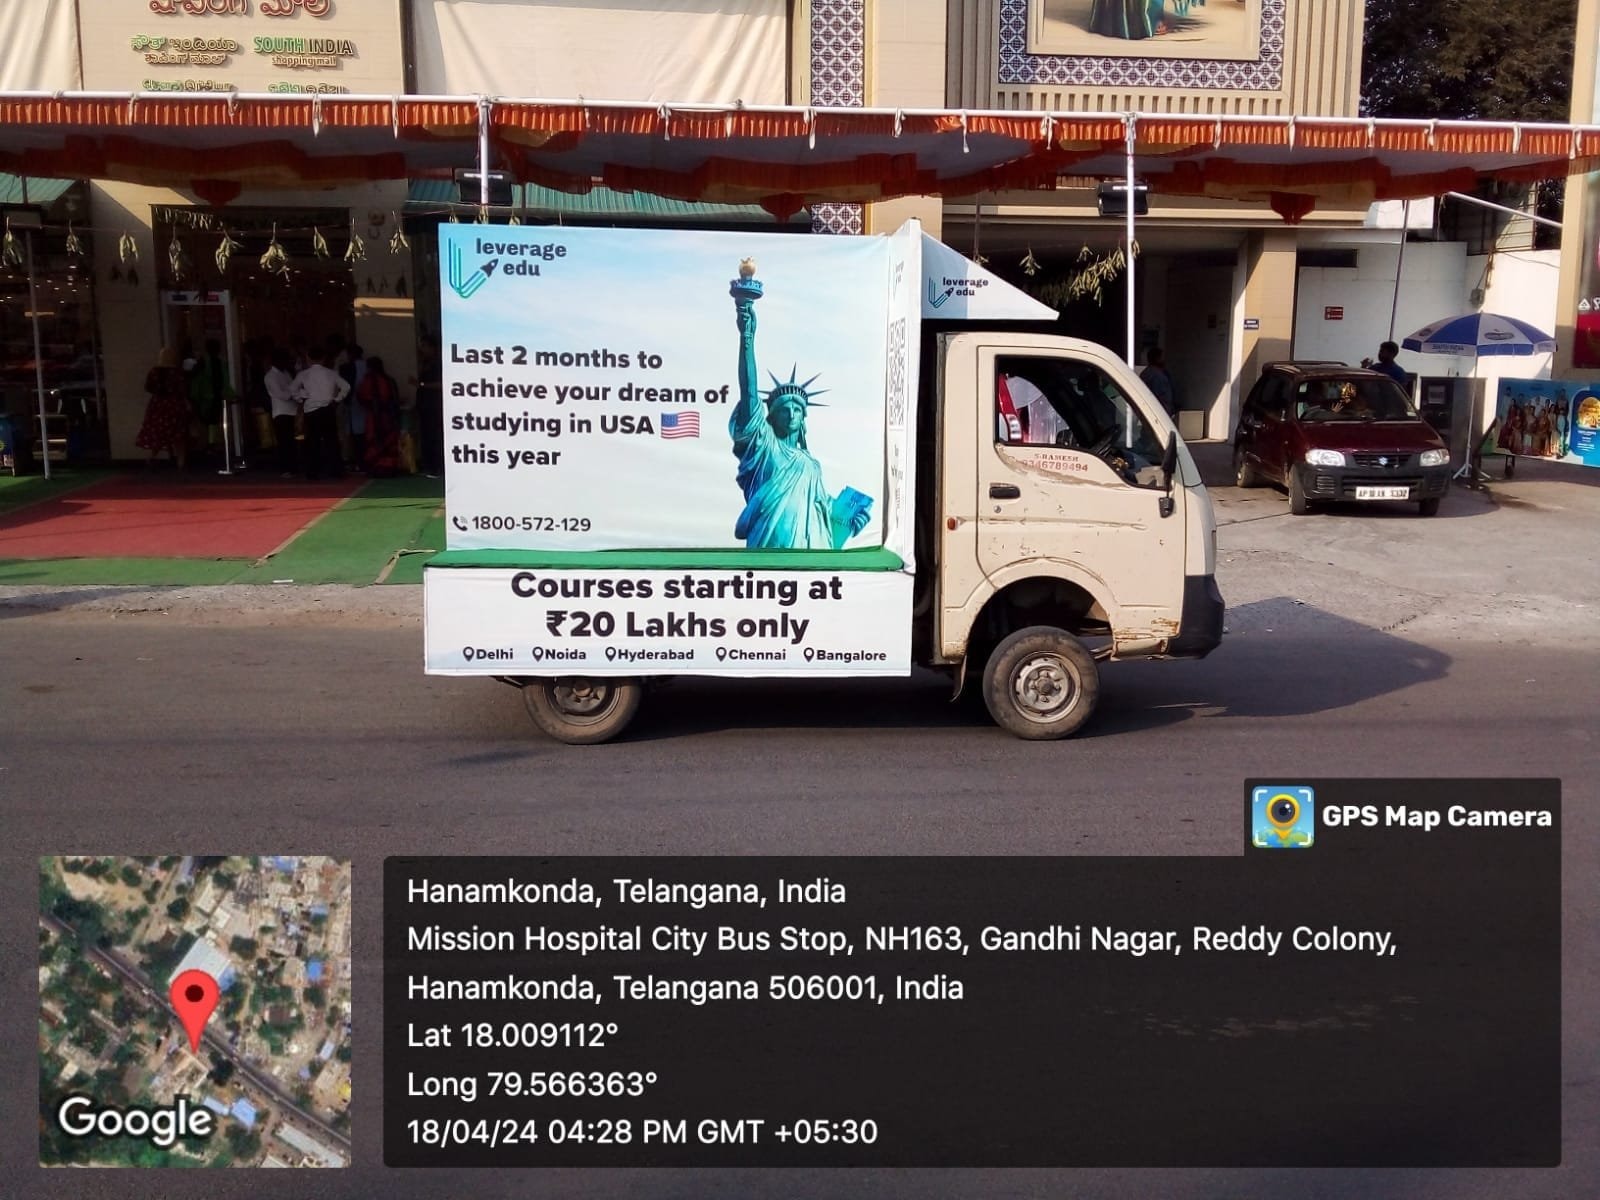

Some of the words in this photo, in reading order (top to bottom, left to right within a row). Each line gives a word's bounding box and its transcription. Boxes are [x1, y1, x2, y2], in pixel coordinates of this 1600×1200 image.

[254, 36, 304, 53] SOUTH
[308, 38, 353, 55] INDIA
[271, 55, 315, 68] shopping
[316, 56, 336, 67] mall
[476, 238, 567, 260] leverage
[503, 258, 541, 276] edu
[942, 276, 989, 288] leverage
[955, 286, 976, 297] edu
[451, 343, 504, 365] Last
[511, 345, 527, 365] 2
[535, 348, 630, 369] months
[637, 350, 663, 369] to
[451, 377, 548, 400] achieve
[554, 385, 611, 405] your
[618, 382, 696, 403] dream
[704, 384, 729, 404] of
[451, 411, 561, 437] studying
[569, 412, 592, 433] in
[600, 415, 655, 435] USA
[451, 443, 500, 464] this
[506, 450, 562, 470] year
[472, 515, 591, 532] 1800-572-129
[511, 571, 653, 599] Courses
[663, 571, 798, 607] starting
[810, 573, 843, 600] at
[546, 610, 615, 637] ₹20
[627, 611, 726, 638] Lakhs
[736, 612, 810, 645] only
[476, 646, 514, 661] Delhi
[545, 646, 587, 661] Noida
[617, 646, 694, 663] Hyderabad
[728, 646, 786, 661] Chennai
[816, 647, 887, 664] Bangalore
